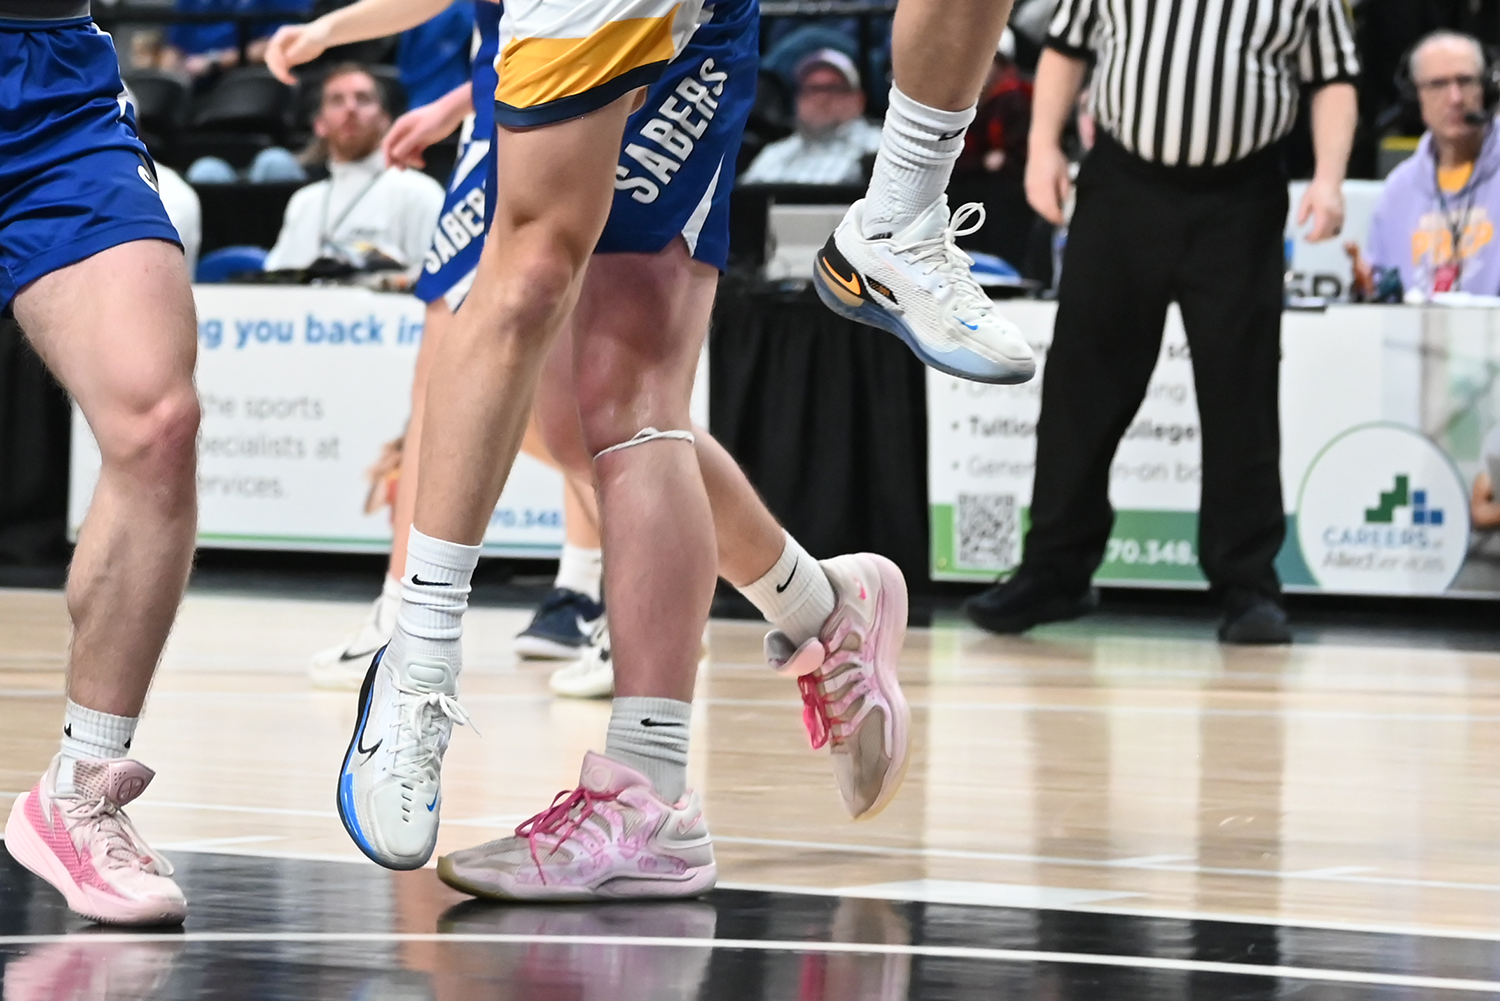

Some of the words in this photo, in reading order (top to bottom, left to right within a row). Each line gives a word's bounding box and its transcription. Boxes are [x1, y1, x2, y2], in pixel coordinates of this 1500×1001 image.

[613, 57, 729, 205] SABERS
[234, 321, 294, 350] you
[304, 312, 384, 344] back
[245, 395, 325, 421] sports
[1322, 527, 1431, 549] CAREERS
